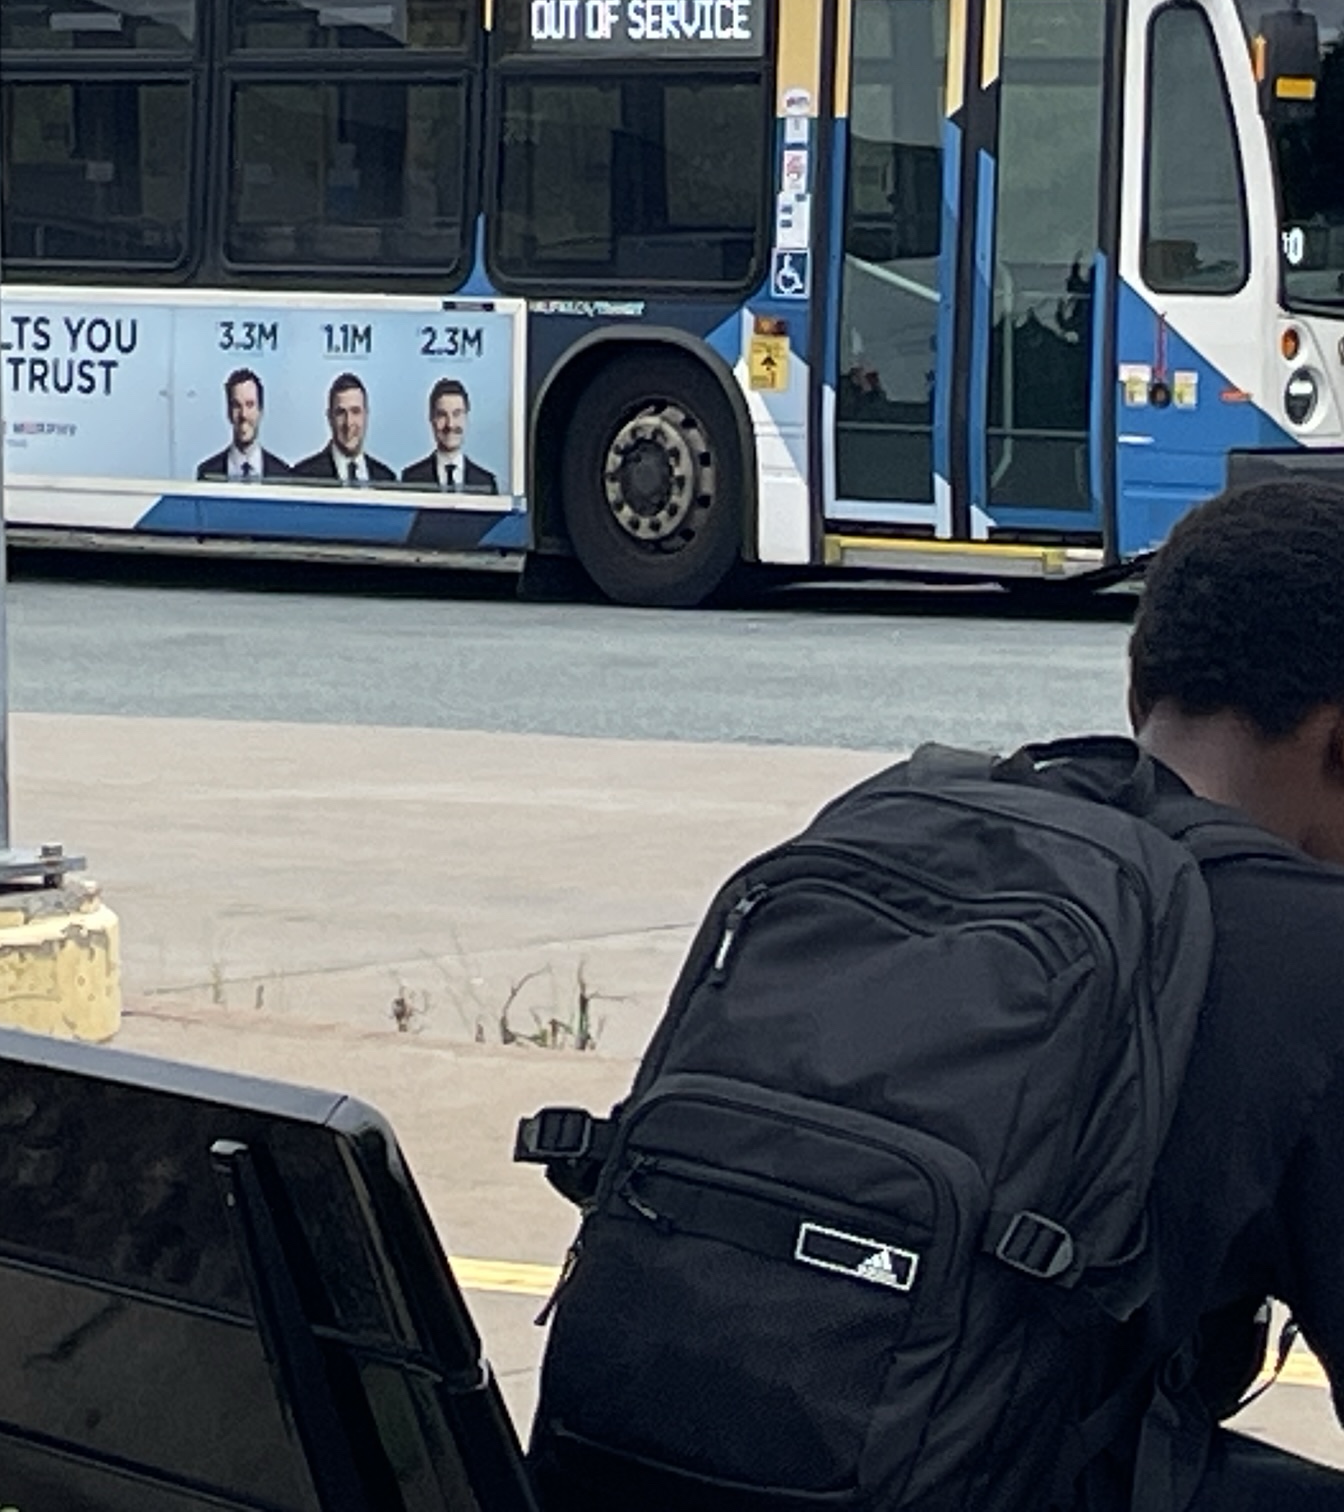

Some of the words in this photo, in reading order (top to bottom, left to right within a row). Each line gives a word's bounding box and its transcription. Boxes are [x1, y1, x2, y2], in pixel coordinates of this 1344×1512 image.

[1, 316, 51, 351] TS
[63, 316, 137, 354] YOU
[219, 321, 279, 351] 3.3M
[323, 324, 372, 354] 1.1M
[421, 326, 484, 357] 2.3M
[7, 357, 118, 396] TRUST
